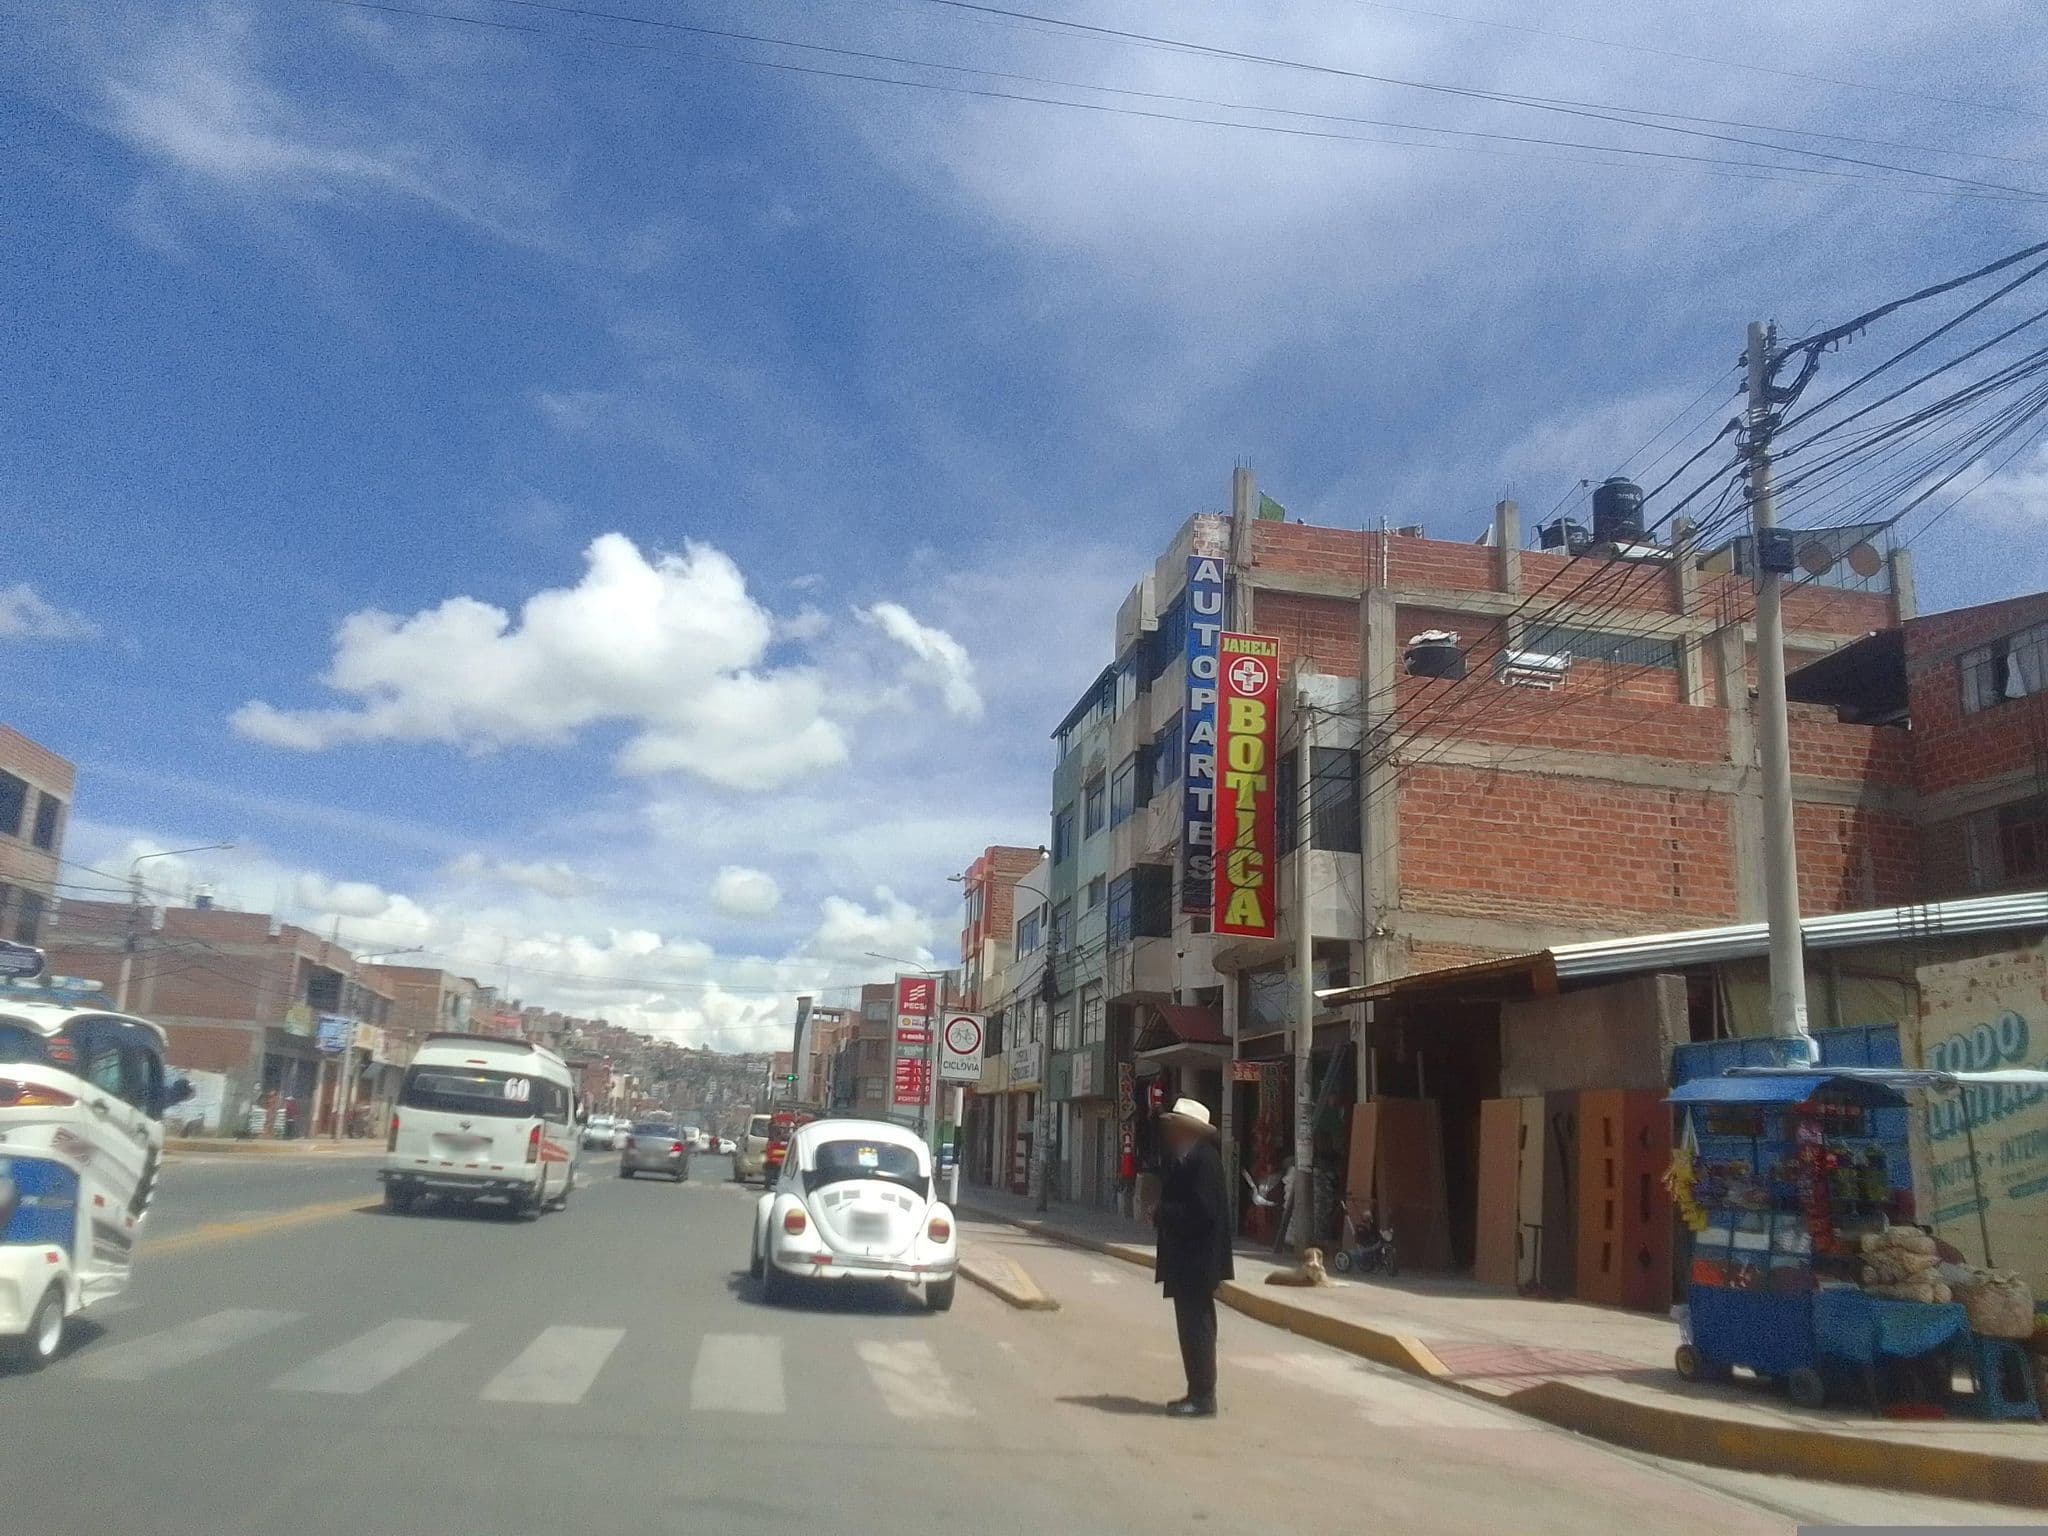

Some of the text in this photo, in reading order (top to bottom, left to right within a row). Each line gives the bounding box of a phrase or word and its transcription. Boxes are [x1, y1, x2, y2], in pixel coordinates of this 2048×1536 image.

[1188, 559, 1221, 881] AUTOPARTES
[1224, 697, 1267, 927] BOTICA
[504, 1077, 530, 1102] 60
[943, 1060, 980, 1071] CICLOVIA
